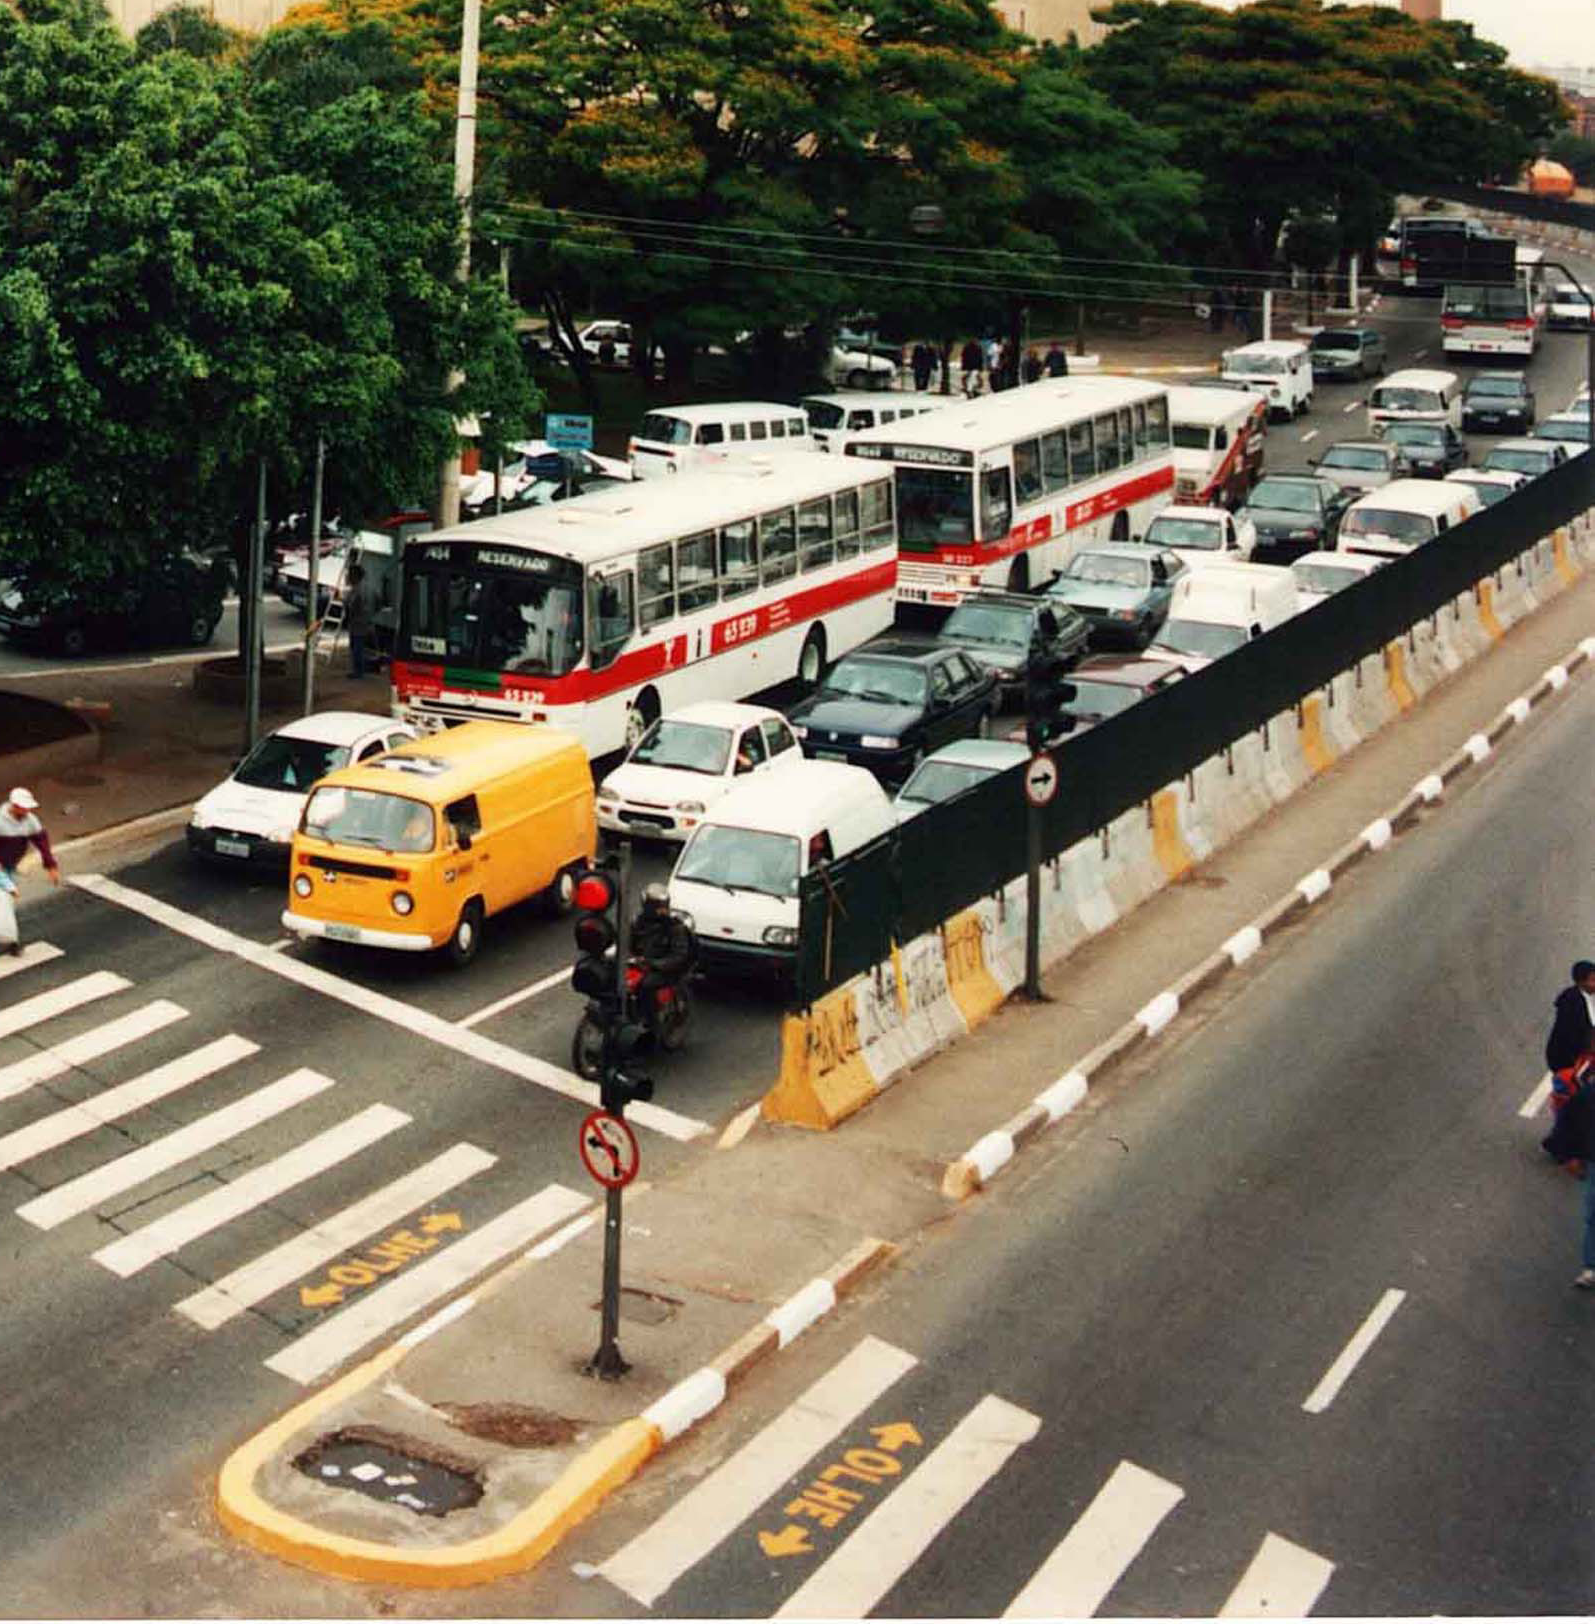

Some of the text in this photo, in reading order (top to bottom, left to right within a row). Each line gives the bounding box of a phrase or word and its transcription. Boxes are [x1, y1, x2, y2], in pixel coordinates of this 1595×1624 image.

[477, 550, 550, 572] RESERVADO
[328, 1229, 439, 1286] OLHE
[783, 1447, 903, 1529] OLHE
